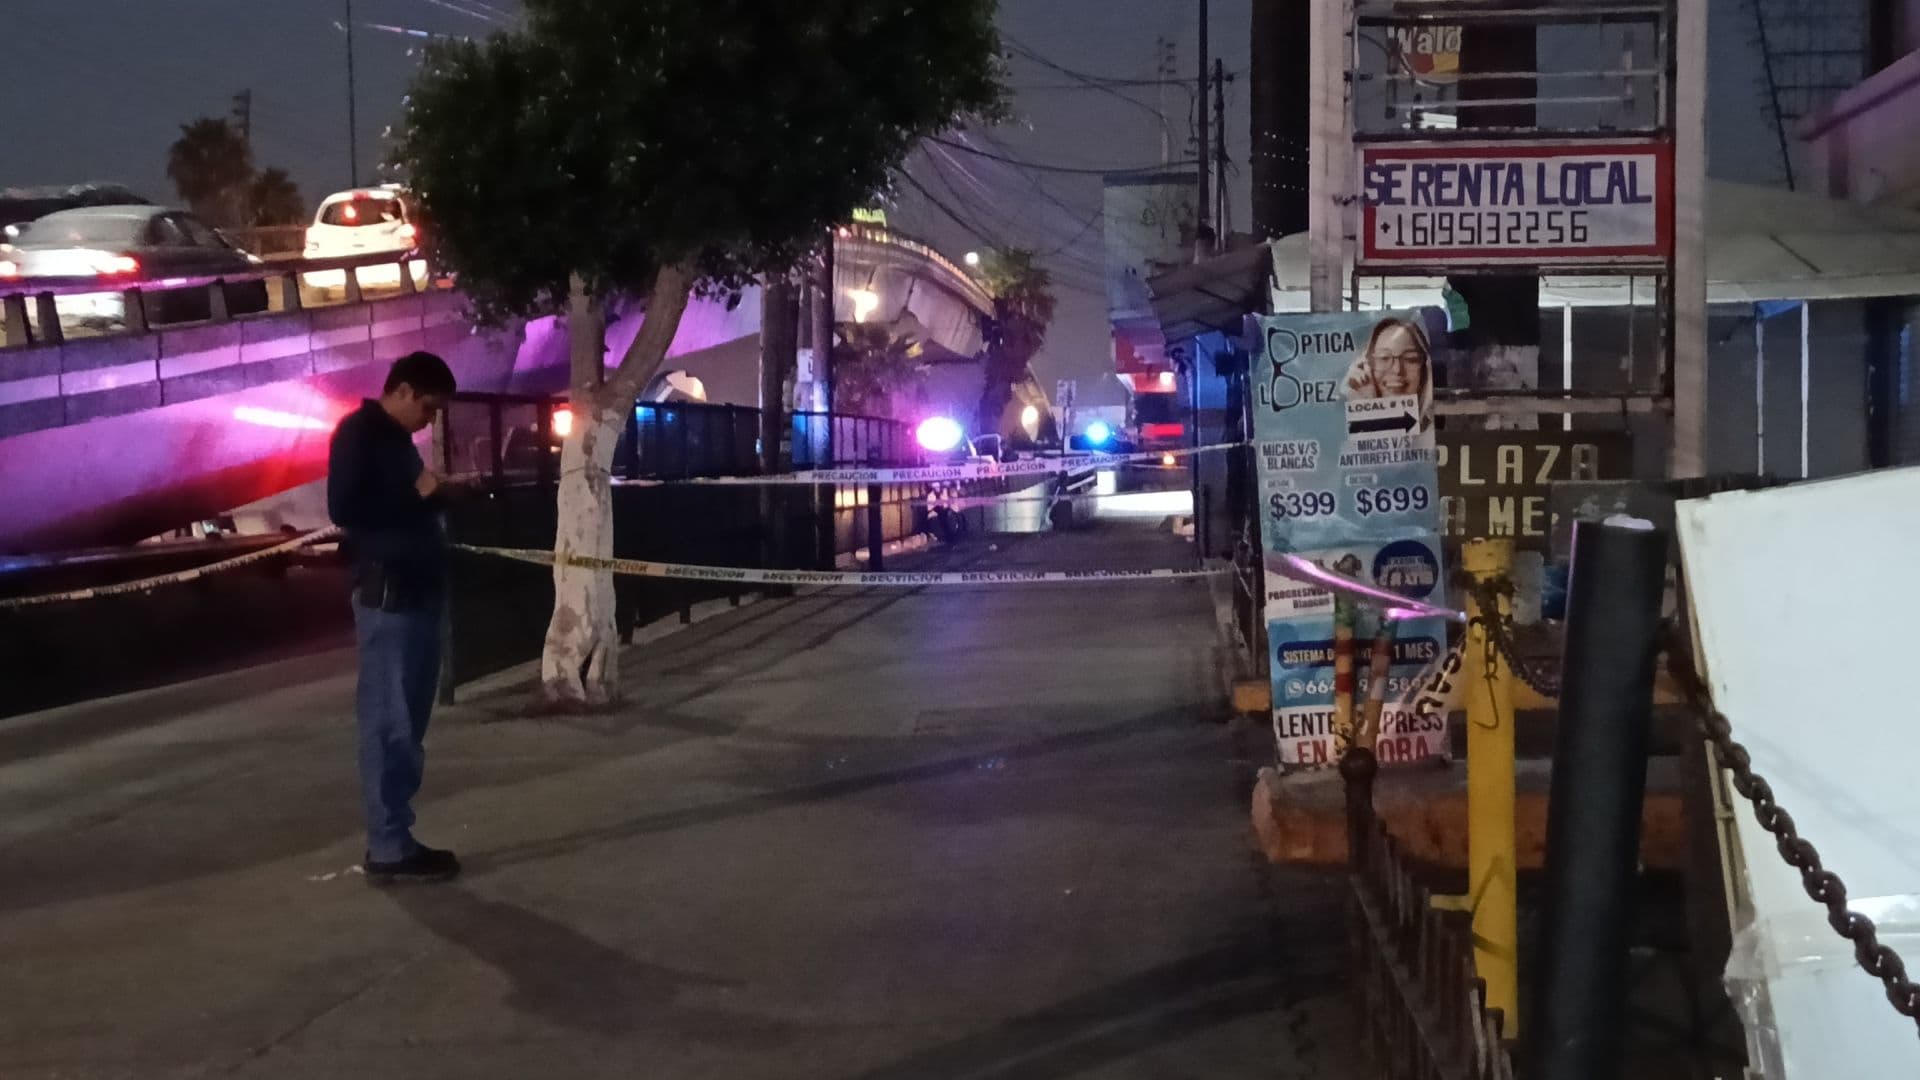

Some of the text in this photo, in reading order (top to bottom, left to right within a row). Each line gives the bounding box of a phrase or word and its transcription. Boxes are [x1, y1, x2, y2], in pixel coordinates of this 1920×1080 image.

[1364, 161, 1652, 206] SE RENTA LOCAL
[1348, 402, 1386, 413] LOCAL
[1262, 442, 1319, 456] MICAS V/S
[1357, 436, 1411, 451] MICAS V/S
[1267, 457, 1315, 470] BLANCAS
[812, 471, 877, 480] PRECAUCION
[892, 468, 961, 479] PRECAUCION
[1270, 491, 1335, 521] $399
[1356, 486, 1429, 516] $699
[1283, 650, 1326, 664] SISTEMA
[1405, 642, 1435, 659] MES
[1278, 711, 1337, 738] LENTE
[1296, 740, 1329, 766] EN
